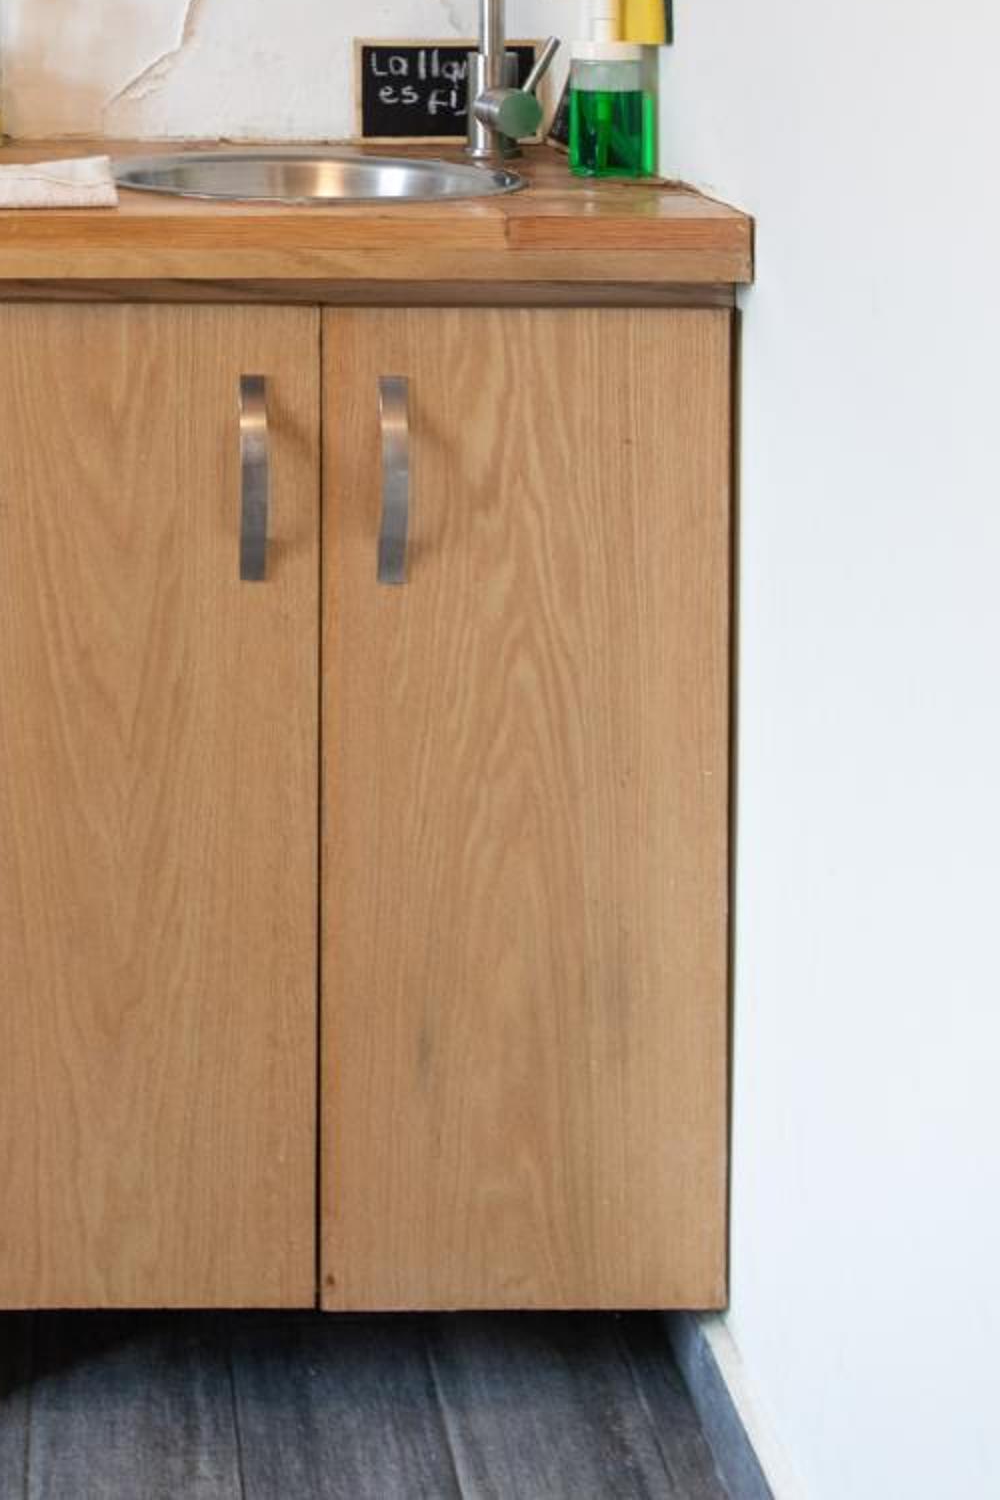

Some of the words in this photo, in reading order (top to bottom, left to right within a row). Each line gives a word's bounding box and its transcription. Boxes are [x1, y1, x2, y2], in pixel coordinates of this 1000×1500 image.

[371, 51, 408, 77] La
[418, 49, 468, 82] llav
[378, 85, 419, 104] es
